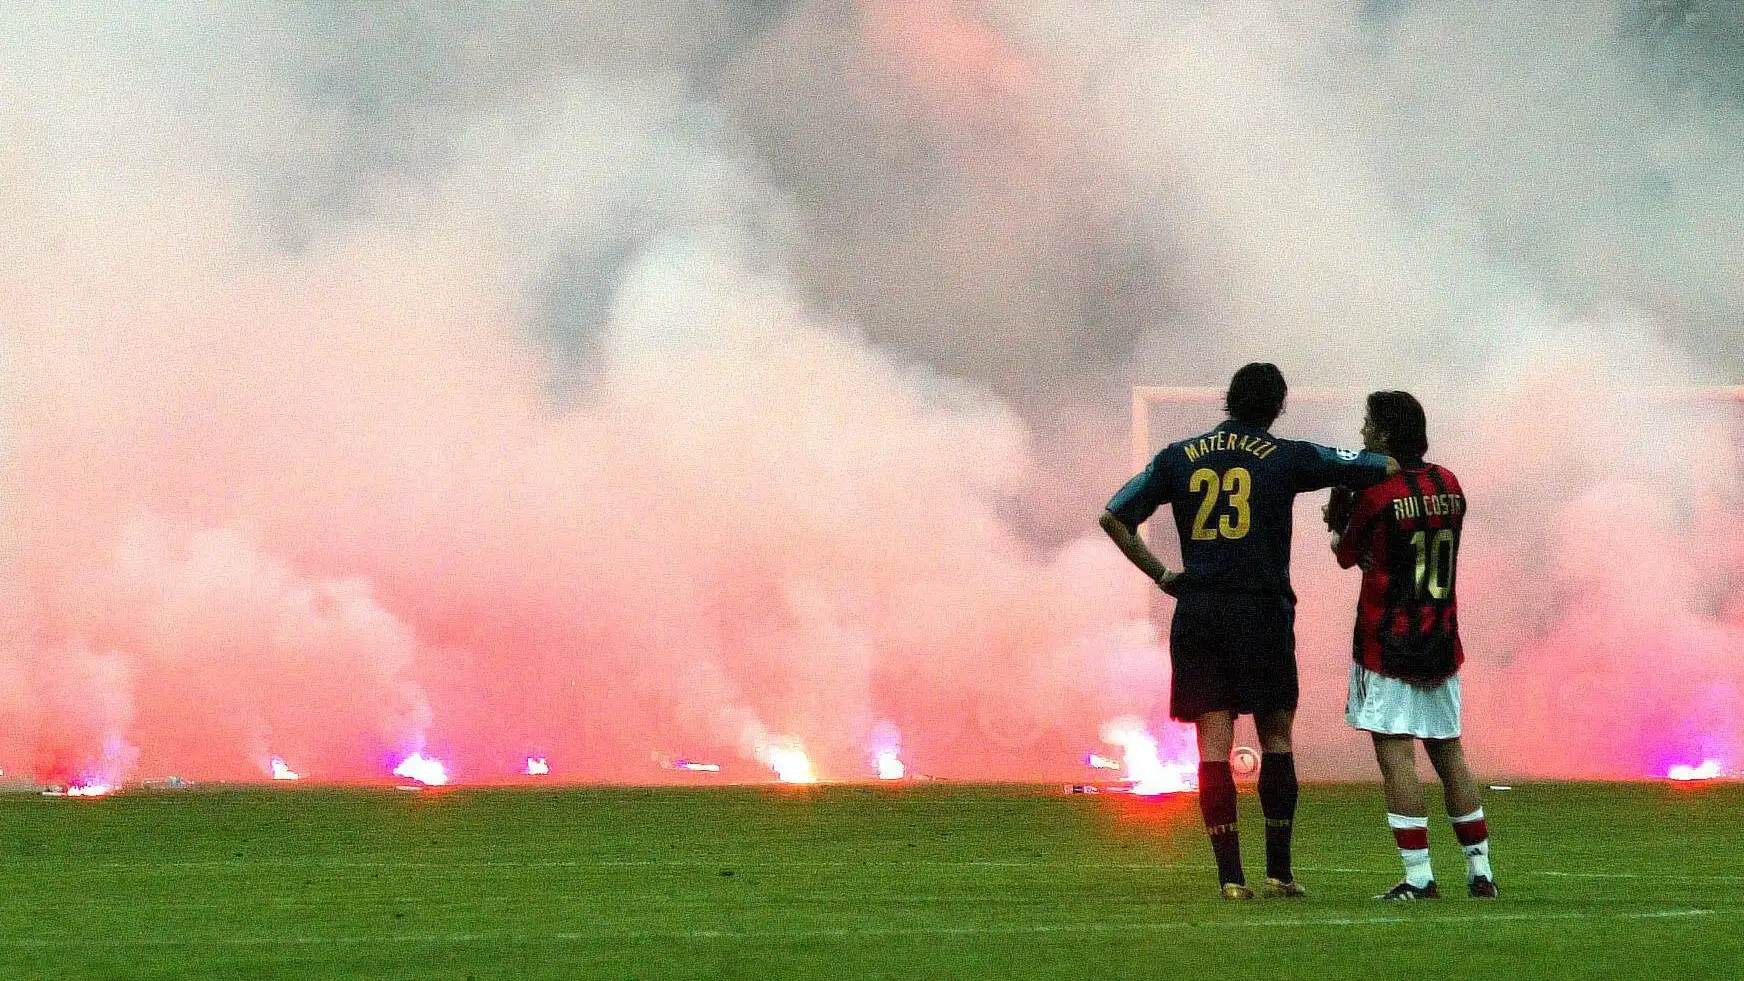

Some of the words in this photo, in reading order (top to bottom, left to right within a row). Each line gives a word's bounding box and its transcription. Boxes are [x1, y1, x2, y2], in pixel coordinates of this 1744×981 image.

[1184, 431, 1277, 462] MATERAZZI
[1189, 467, 1251, 540] 23
[1393, 496, 1420, 520] RUI
[1410, 530, 1453, 599] 10
